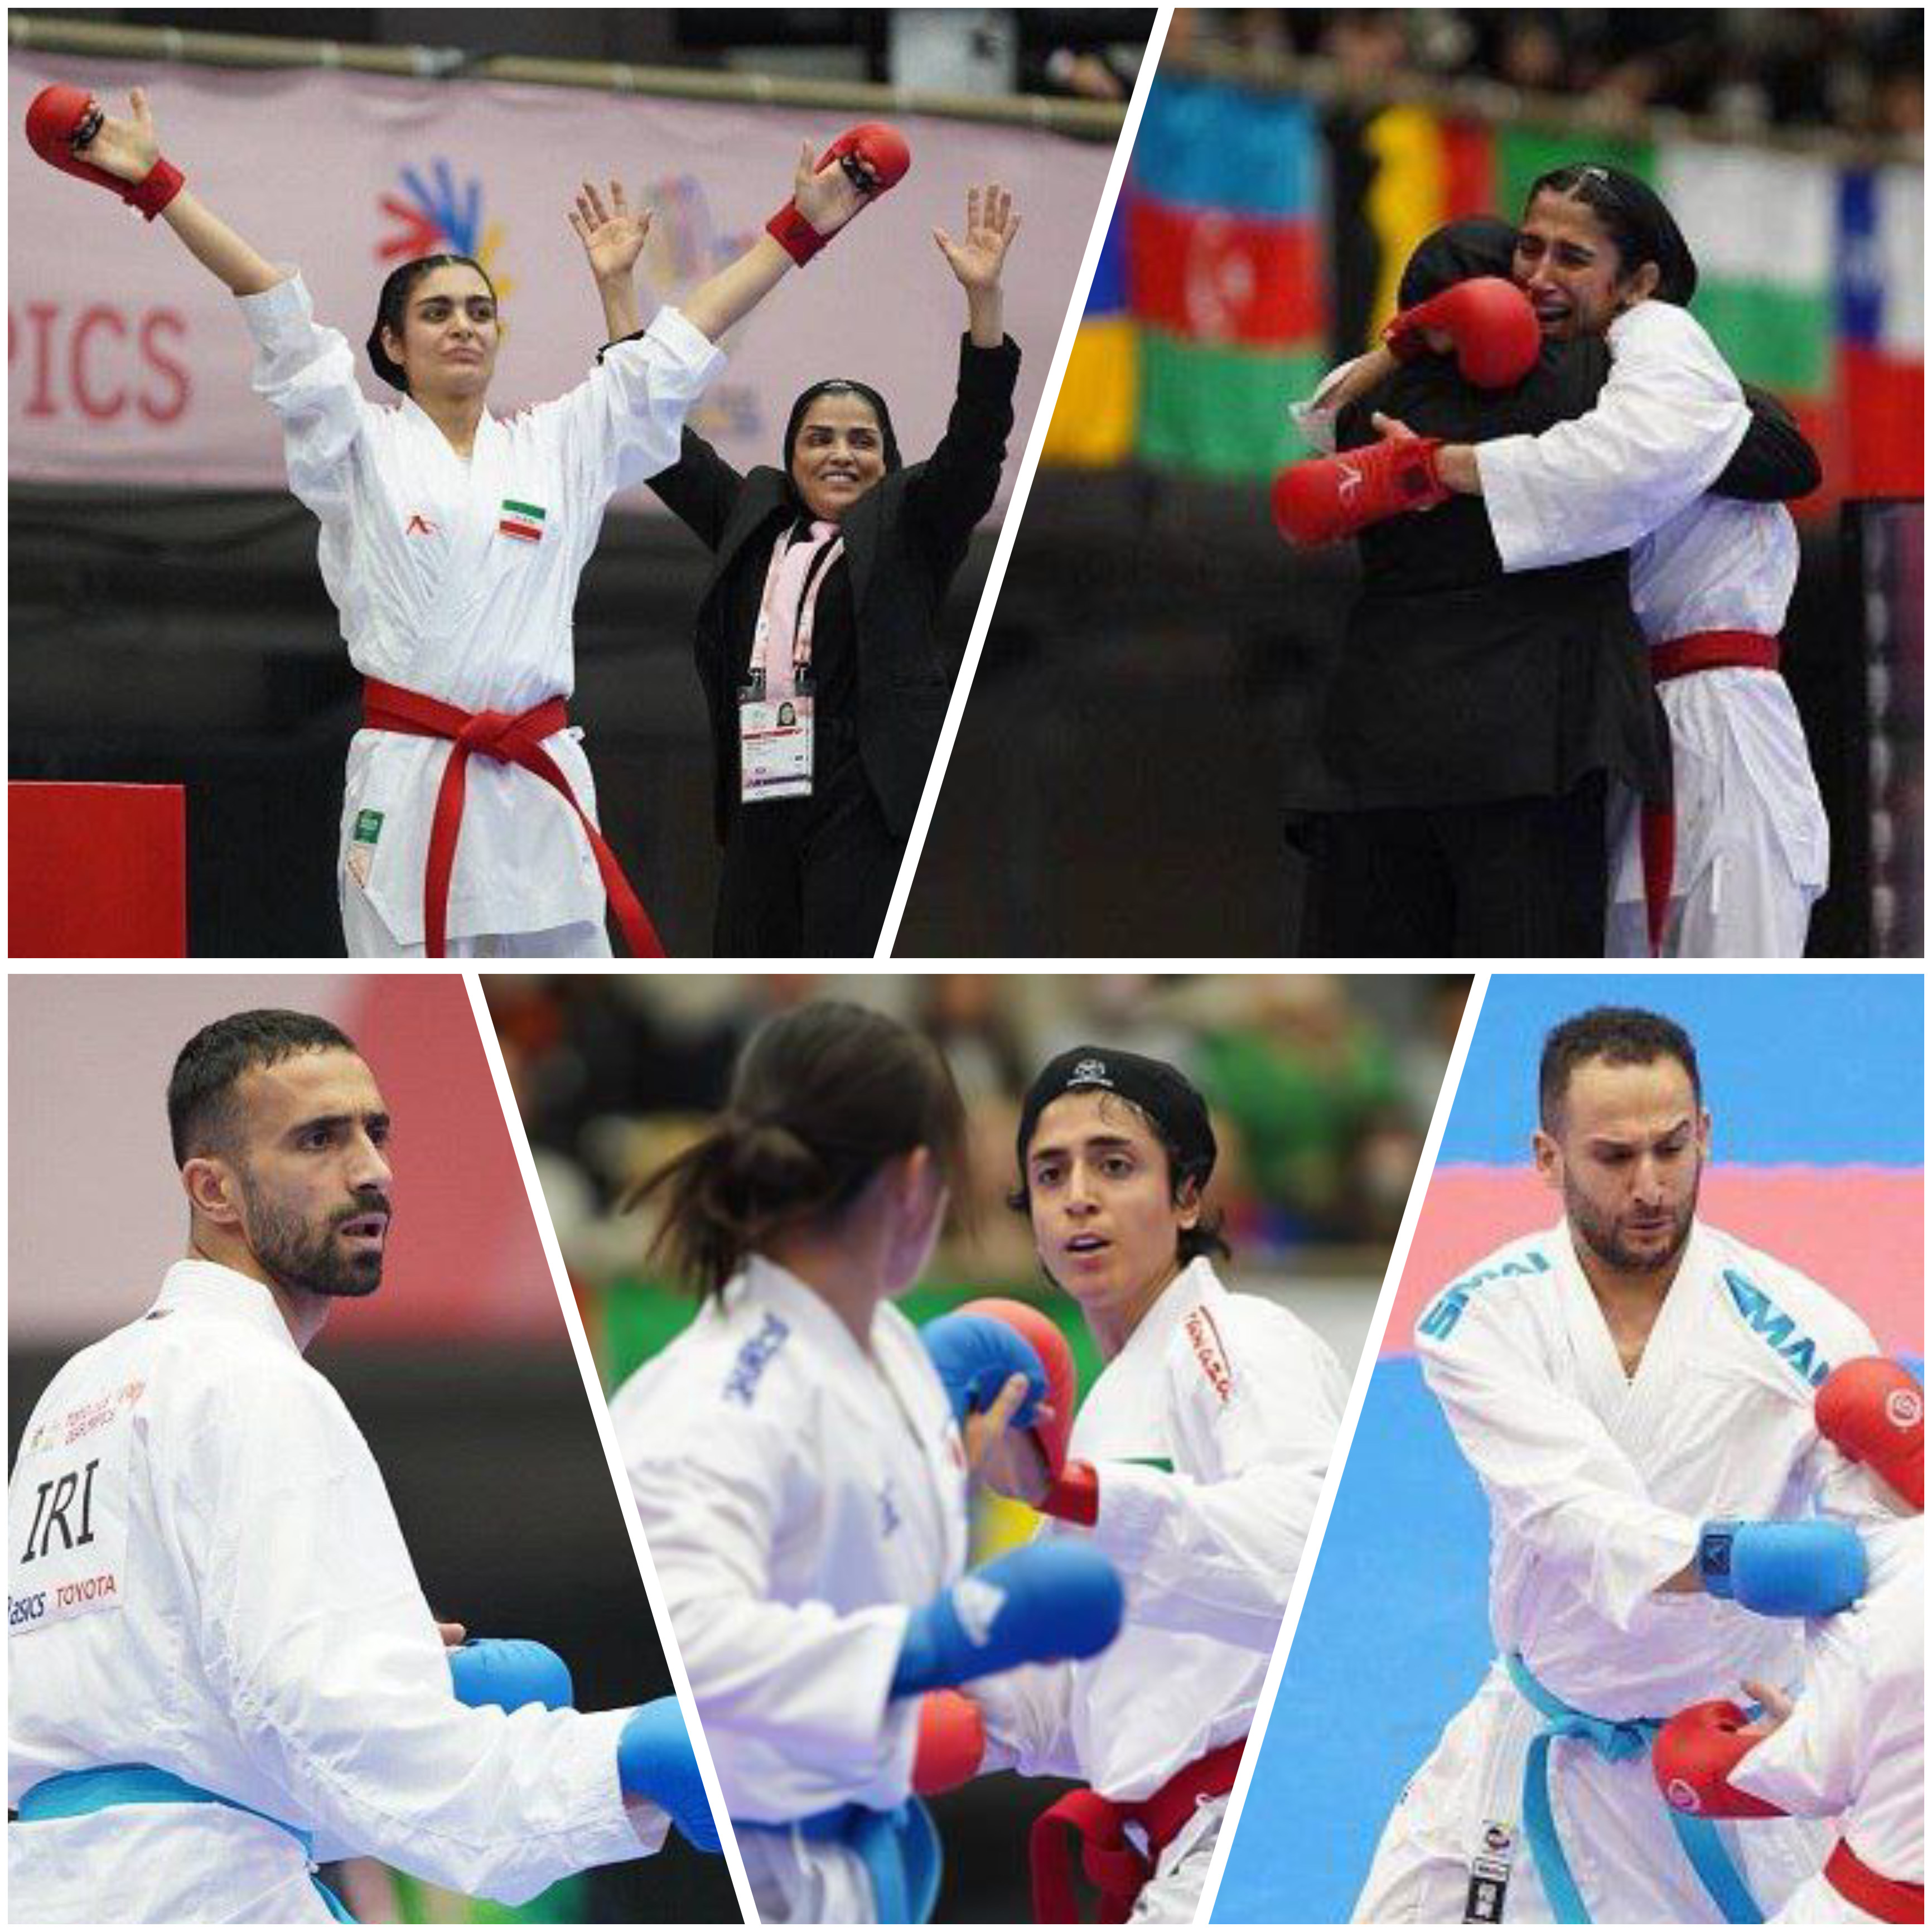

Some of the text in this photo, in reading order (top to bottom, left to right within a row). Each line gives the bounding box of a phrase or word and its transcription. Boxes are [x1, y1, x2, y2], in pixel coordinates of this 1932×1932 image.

[8, 301, 192, 423] ICS
[21, 1459, 99, 1564] IRI
[57, 1574, 116, 1607] TOYOTA
